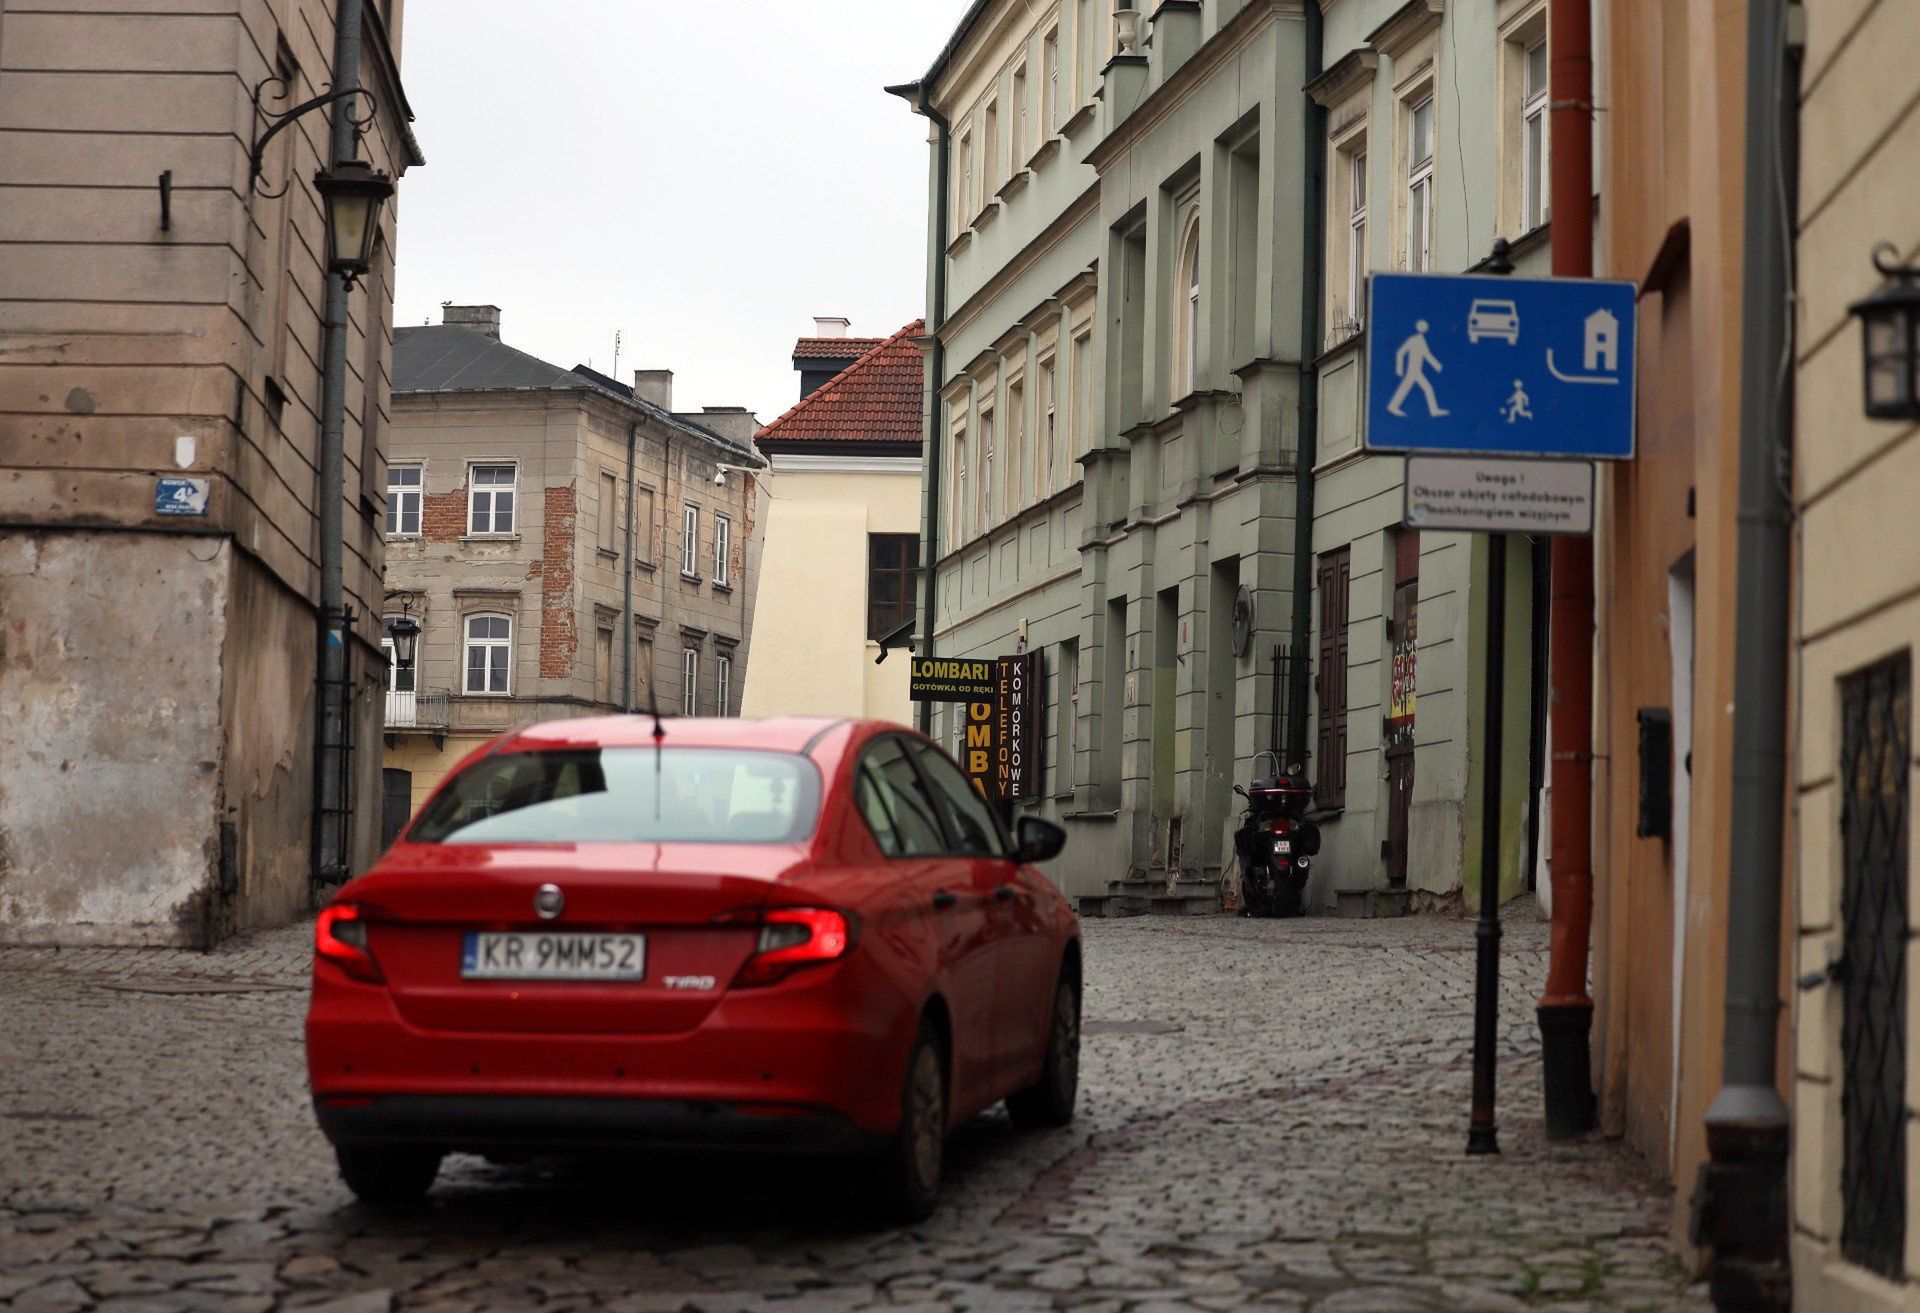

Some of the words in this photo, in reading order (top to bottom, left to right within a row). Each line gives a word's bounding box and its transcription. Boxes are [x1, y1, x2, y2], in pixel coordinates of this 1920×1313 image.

[1475, 471, 1516, 486] Uwaga
[1413, 485, 1456, 498] Obszar
[1428, 504, 1514, 520] monitoringiem
[1519, 508, 1571, 522] wizyjnym
[973, 686, 994, 695] RĘKI
[999, 662, 1009, 796] TELEFONY
[1011, 662, 1022, 796] KOMÓRKOWE
[483, 937, 525, 969] KR
[537, 937, 637, 970] 9MM52
